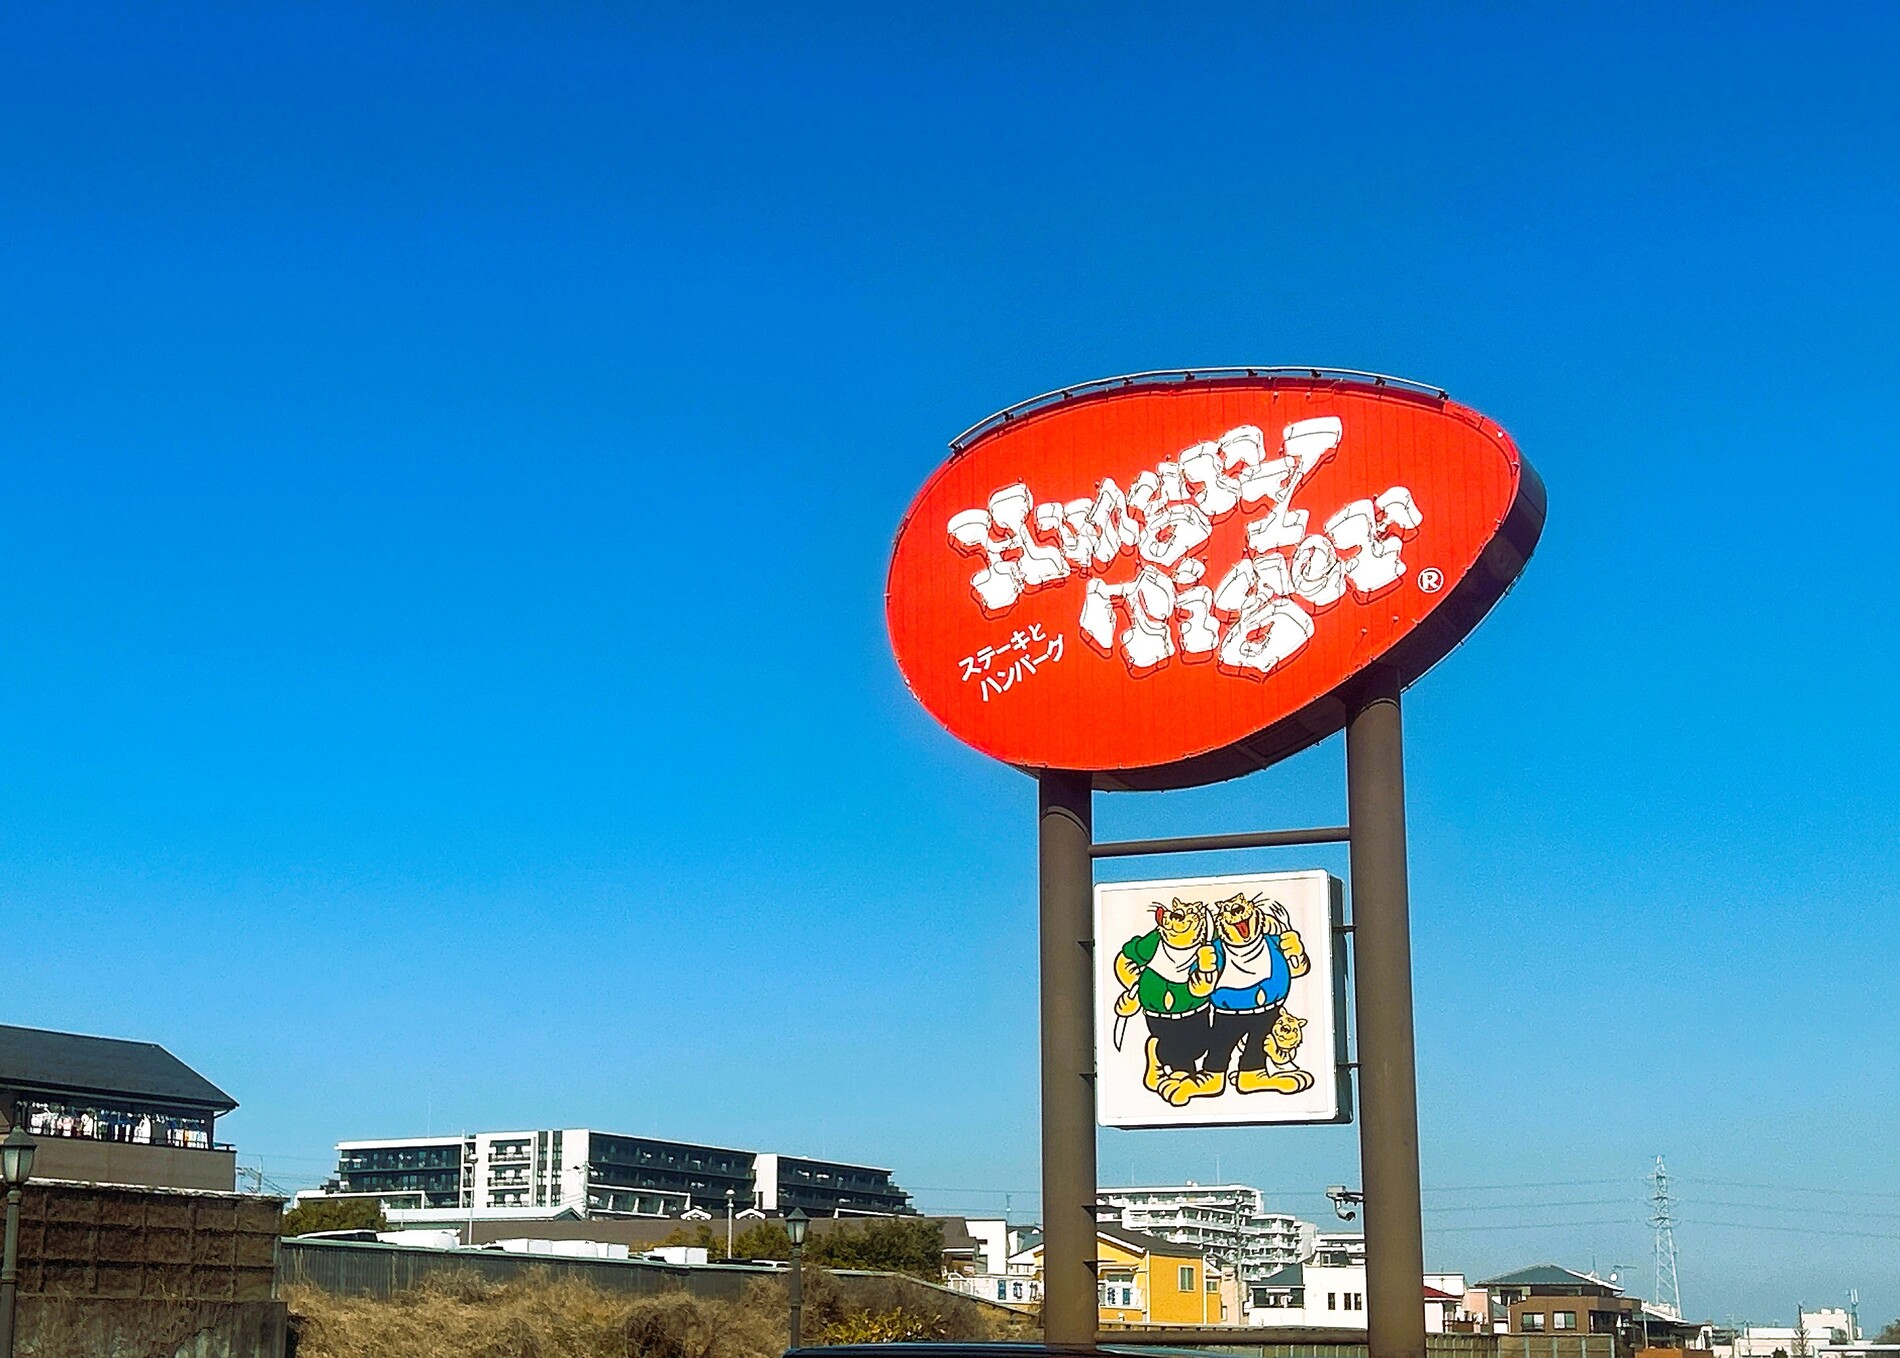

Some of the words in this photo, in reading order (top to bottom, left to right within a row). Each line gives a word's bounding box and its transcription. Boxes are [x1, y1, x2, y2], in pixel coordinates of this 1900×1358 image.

[1079, 486, 1423, 674] Tiger
[958, 623, 1046, 681] ステーキと
[980, 634, 1063, 702] ハンバーグ
